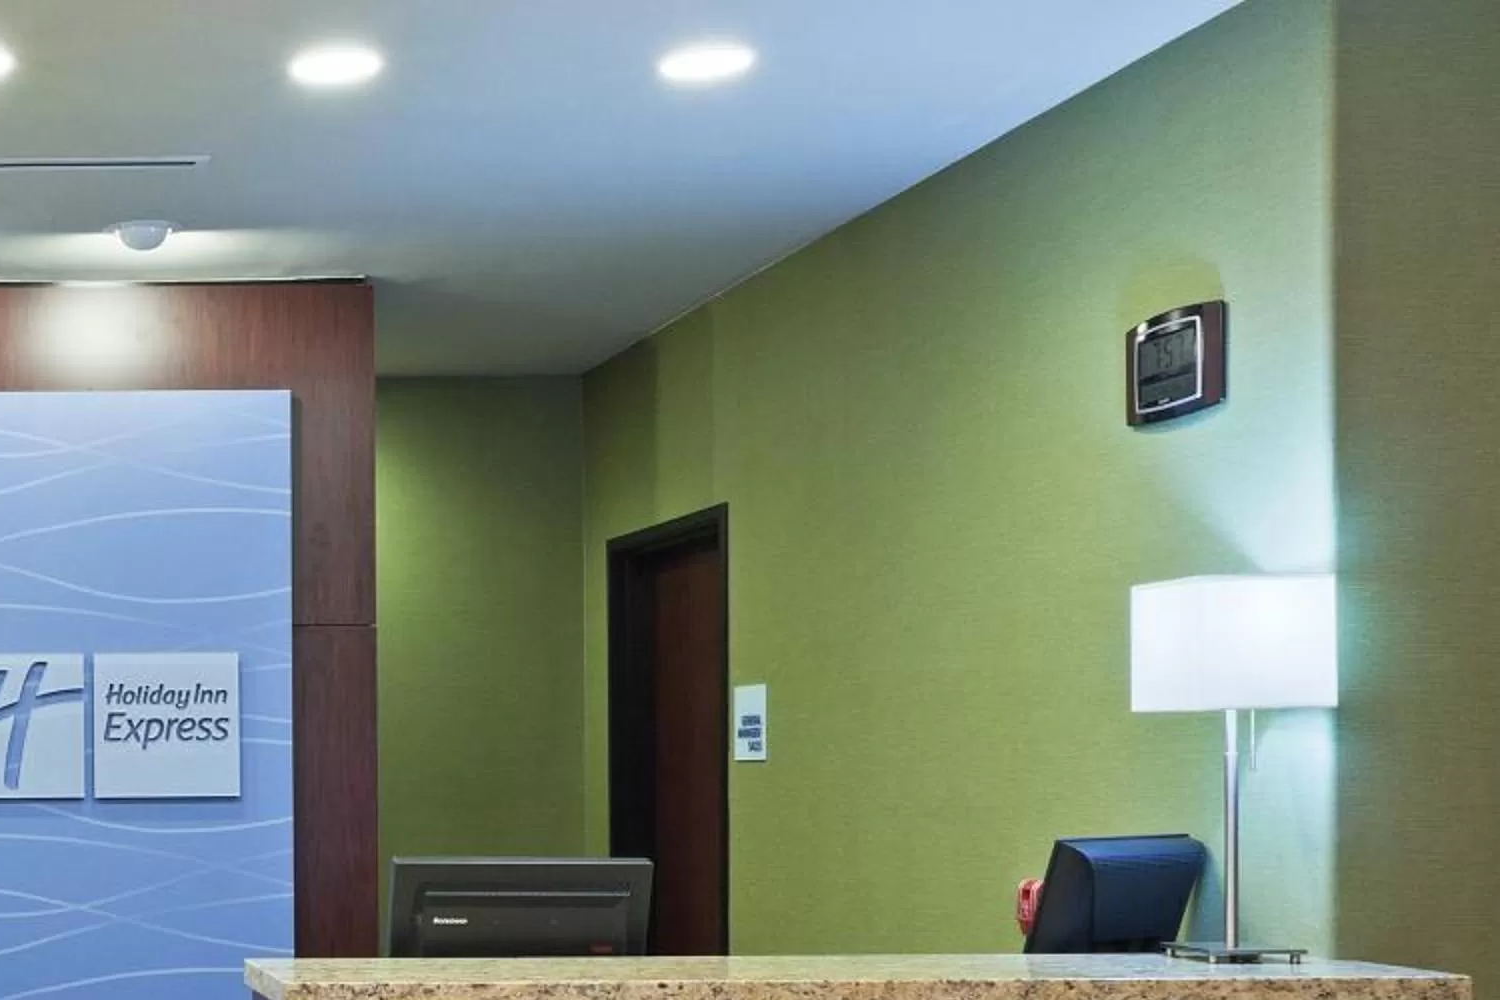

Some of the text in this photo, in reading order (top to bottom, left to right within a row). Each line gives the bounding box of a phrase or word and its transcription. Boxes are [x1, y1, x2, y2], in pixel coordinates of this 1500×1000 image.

[105, 683, 229, 709] Holiday Inn
[103, 712, 230, 750] Express
